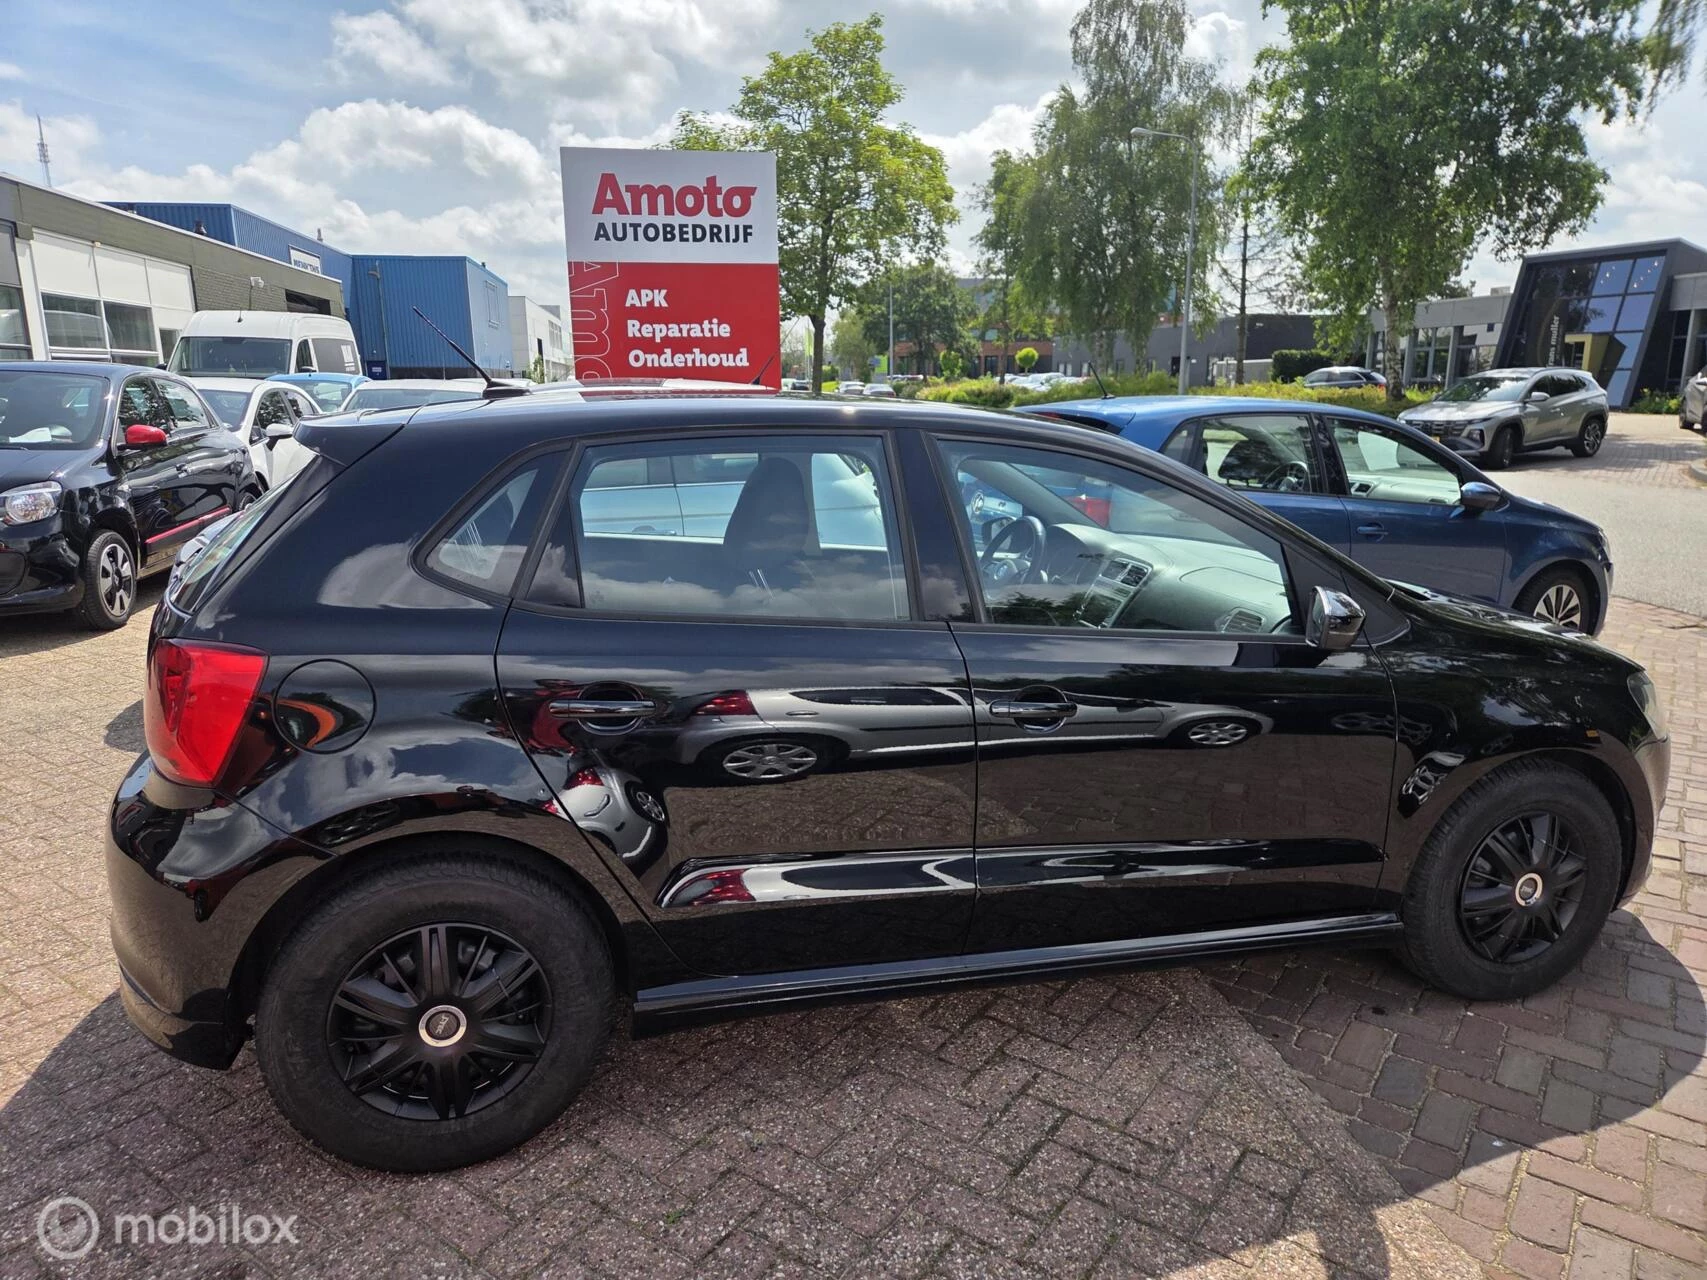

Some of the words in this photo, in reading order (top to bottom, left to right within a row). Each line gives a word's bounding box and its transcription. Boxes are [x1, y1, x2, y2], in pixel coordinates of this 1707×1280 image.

[591, 172, 758, 218] Amoto
[593, 222, 753, 243] AUTOBEDRIJF
[625, 289, 668, 307] APK
[626, 318, 731, 343] Reparatie
[628, 348, 749, 368] Onderhoud
